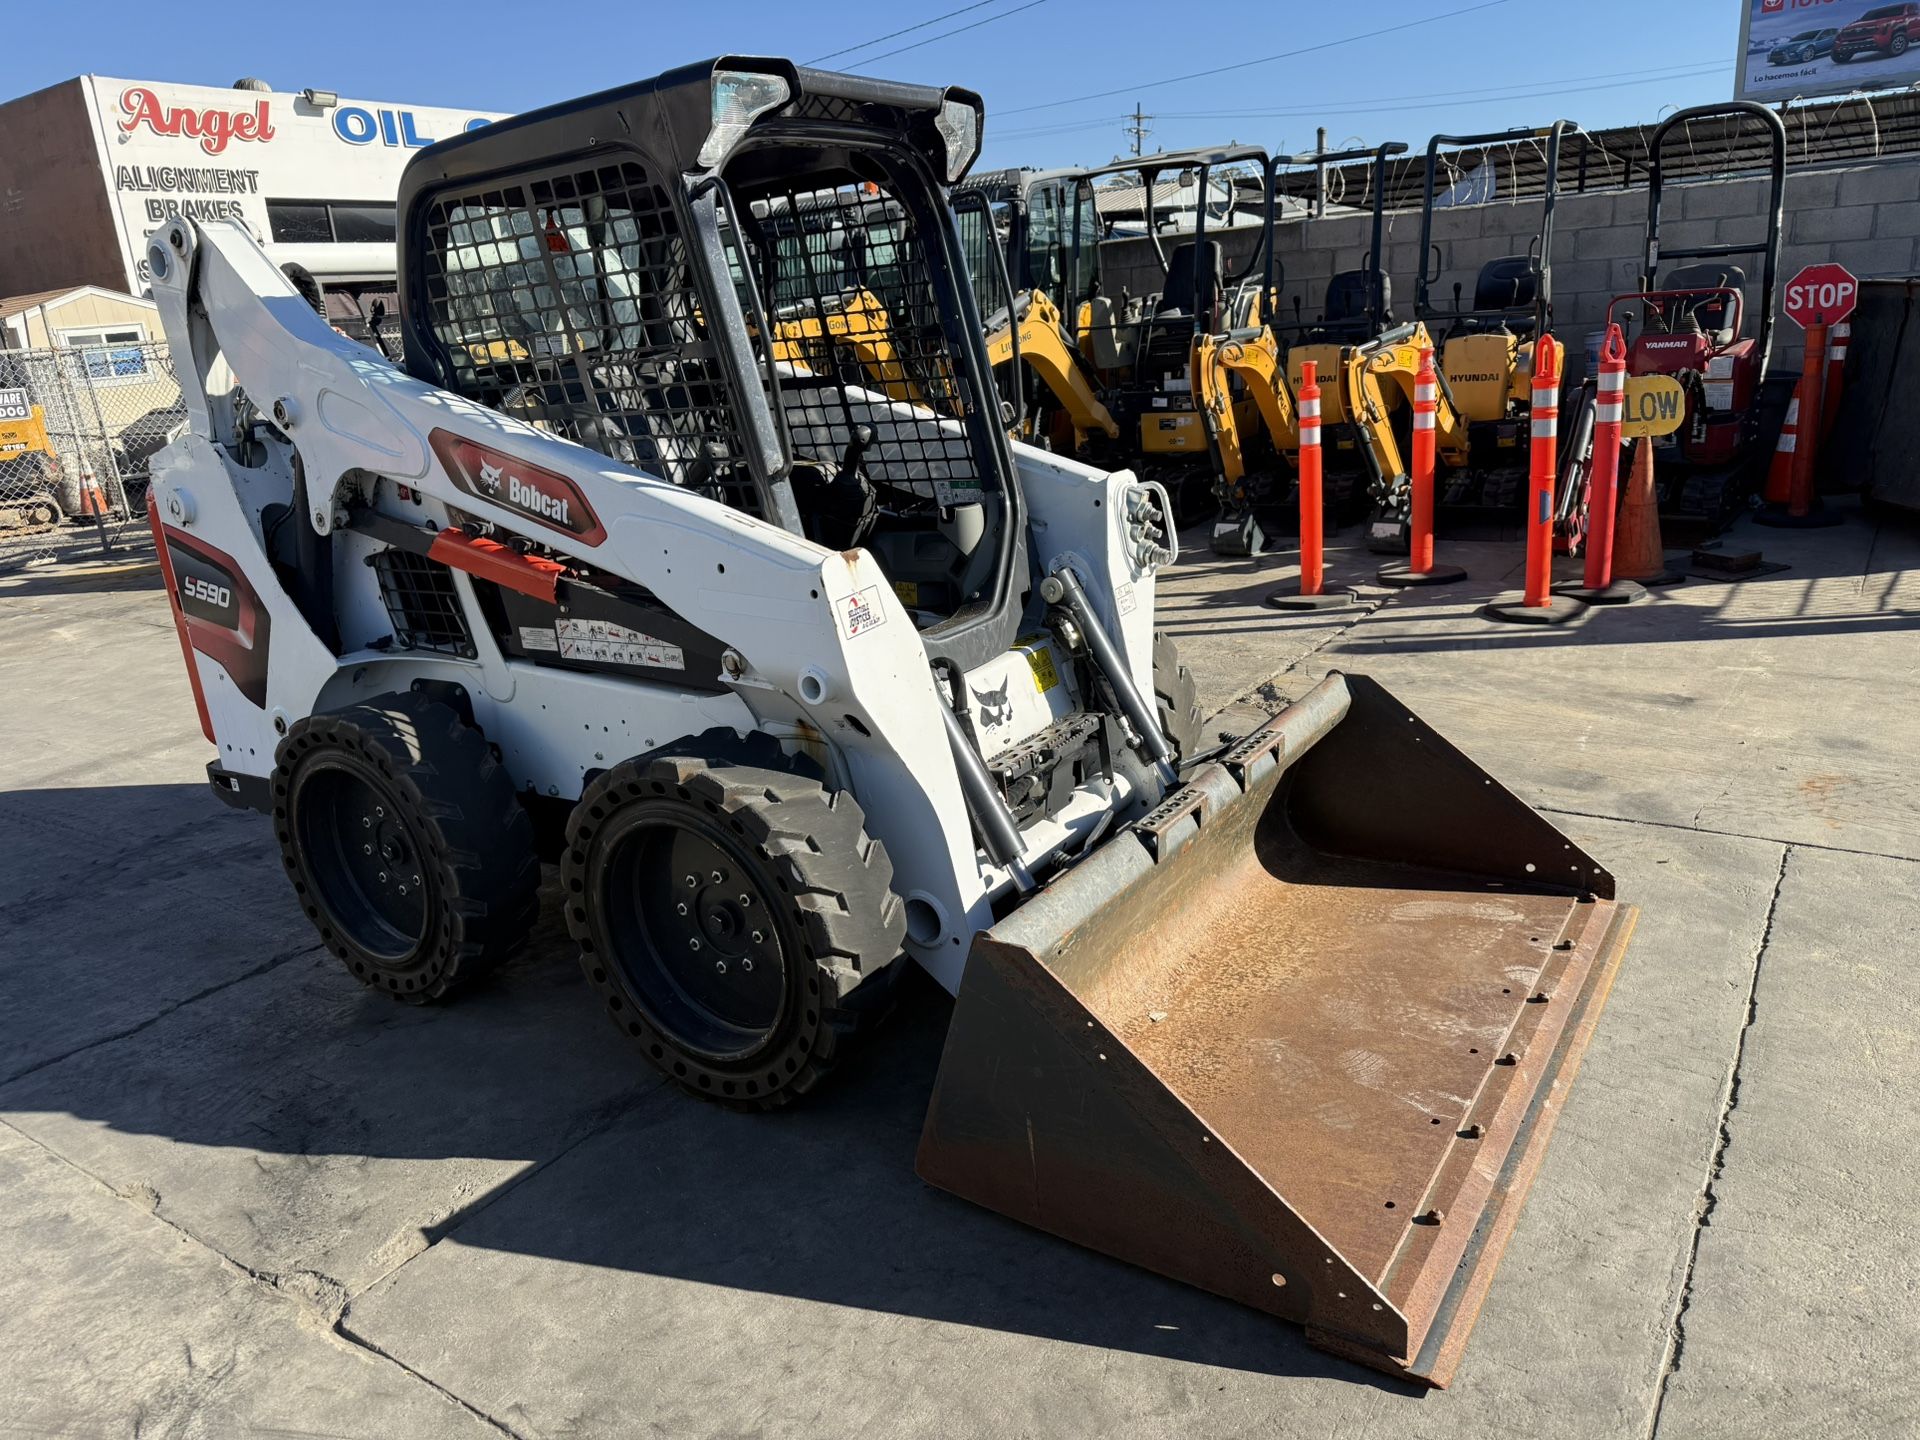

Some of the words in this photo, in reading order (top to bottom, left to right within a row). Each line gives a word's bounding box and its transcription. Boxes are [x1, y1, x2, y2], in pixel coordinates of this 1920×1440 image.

[1754, 75, 1763, 83] Lo
[1764, 71, 1798, 81] hacemos
[1800, 67, 1817, 77] fácil
[118, 87, 276, 155] Angel
[333, 106, 435, 149] OIL
[116, 165, 259, 194] ALIGNMENT
[145, 198, 244, 222] BRAKES
[1787, 282, 1854, 310] STOP
[1645, 340, 1688, 349] YANMAR
[1450, 373, 1499, 383] HYUNDAI
[1621, 390, 1679, 423] LOW
[509, 475, 569, 525] Bobcat
[184, 575, 231, 609] S590
